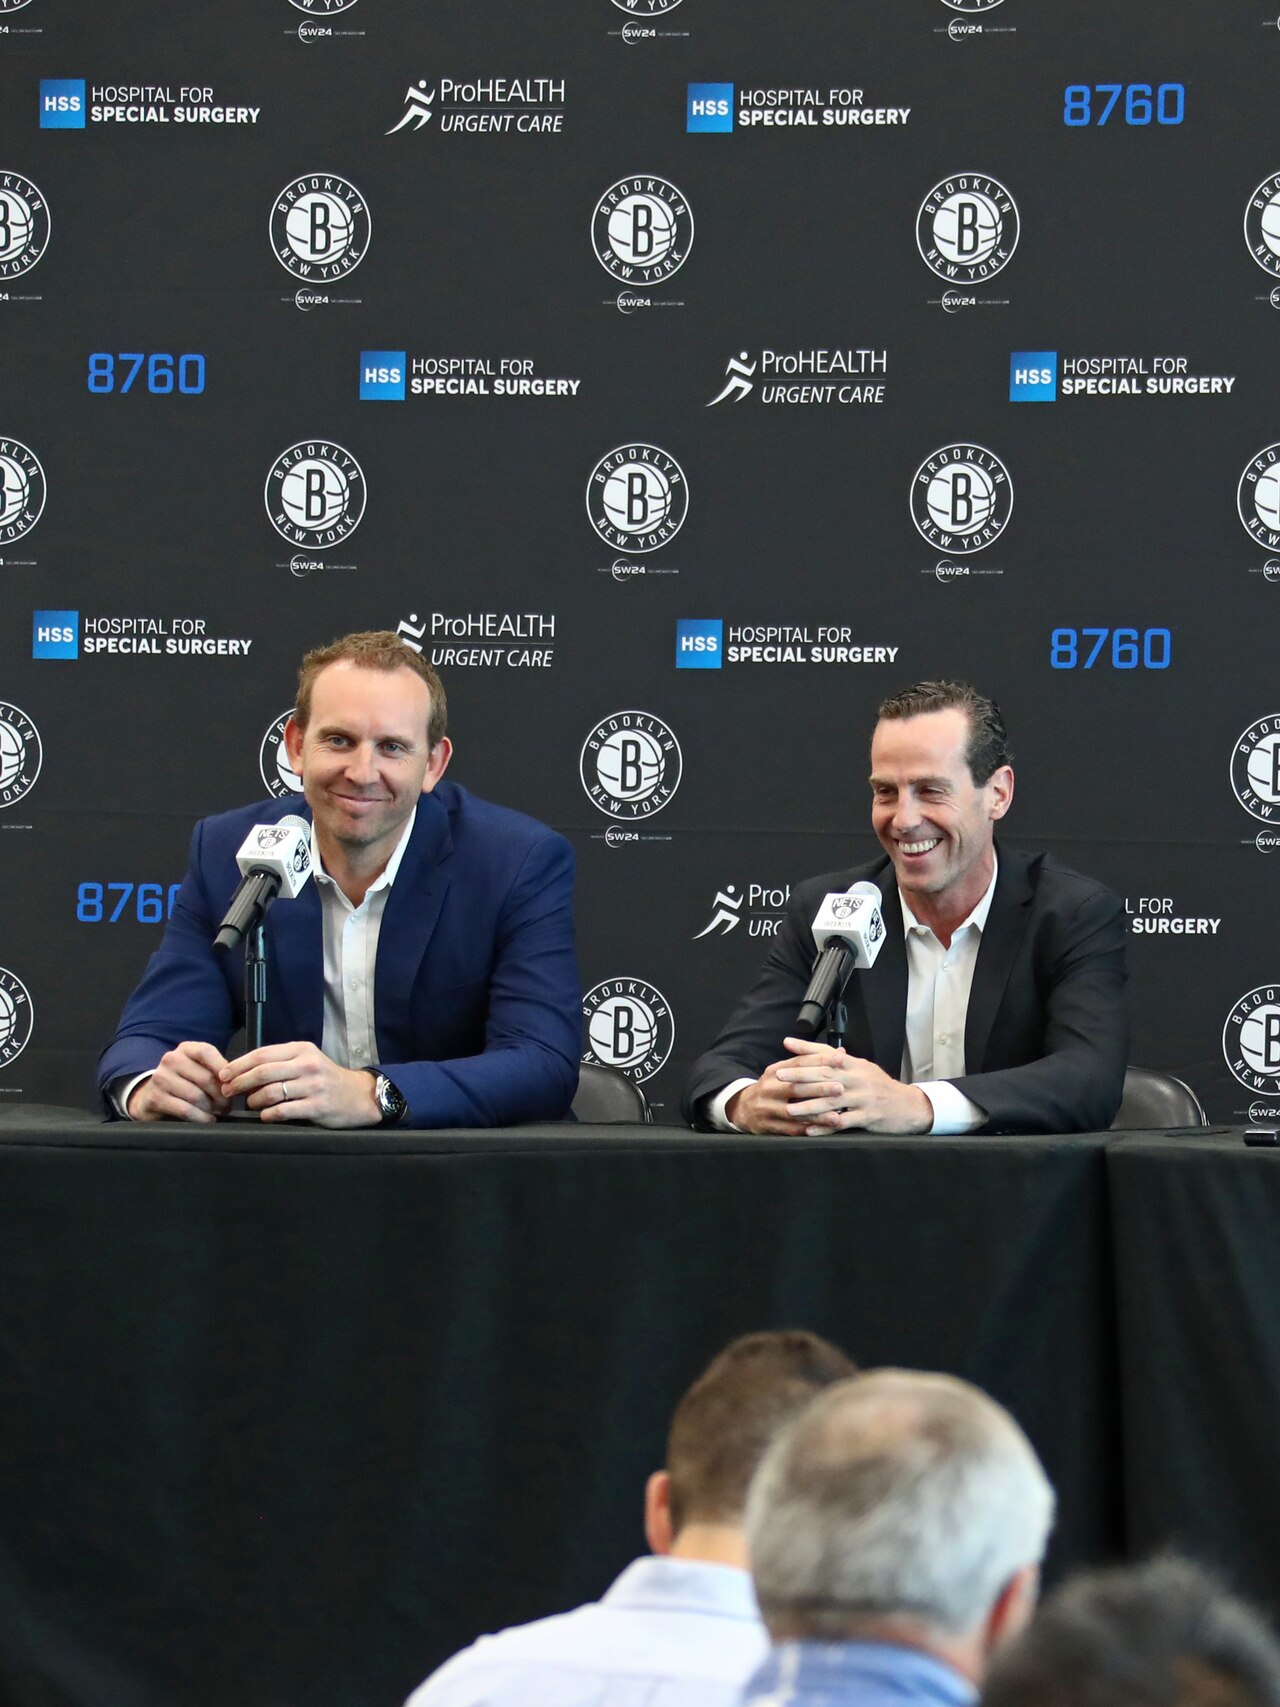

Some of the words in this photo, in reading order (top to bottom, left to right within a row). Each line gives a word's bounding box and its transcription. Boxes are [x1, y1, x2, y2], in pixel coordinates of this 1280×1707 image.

[92, 86, 175, 103] HOSPITAL
[180, 87, 213, 103] FOR
[441, 79, 565, 102] ProHEALTH
[740, 90, 825, 106] HOSPITAL
[830, 89, 863, 105] FOR
[45, 96, 80, 111] HSS
[693, 100, 728, 115] HSS
[1064, 83, 1186, 126] 8760
[91, 106, 169, 122] SPECIAL
[173, 106, 260, 123] SURGERY
[738, 109, 818, 126] SPECIAL
[822, 108, 911, 125] SURGERY
[441, 115, 515, 132] URGENT
[517, 115, 564, 132] CARE
[278, 178, 363, 213] BROOKLYN
[925, 178, 1011, 214] BROOKLYN
[957, 202, 979, 255] B
[280, 247, 311, 275] NEW
[321, 248, 359, 278] YORK
[927, 249, 958, 277] NEW
[968, 249, 1007, 279] YORK
[943, 297, 976, 305] SW24
[412, 358, 496, 375] HOSPITAL
[500, 359, 534, 375] FOR
[762, 350, 887, 373] ProHEALTH
[1064, 358, 1148, 375] HOSPITAL
[1153, 358, 1187, 374] FOR
[88, 353, 206, 395] 8760
[365, 368, 401, 383] HSS
[1016, 369, 1052, 384] HSS
[411, 378, 489, 394] SPECIAL
[493, 379, 581, 395] SURGERY
[762, 386, 836, 403] URGENT
[838, 386, 885, 403] CARE
[1062, 378, 1142, 395] SPECIAL
[1146, 377, 1235, 394] SURGERY
[595, 449, 680, 483] BROOKLYN
[627, 473, 648, 525] B
[597, 518, 628, 546] NEW
[638, 519, 677, 548] YORK
[1248, 518, 1280, 545] NEW
[613, 566, 646, 574] SW24
[85, 618, 168, 634] HOSPITAL
[173, 619, 206, 635] FOR
[432, 613, 555, 637] ProHEALTH
[38, 627, 73, 642] HSS
[729, 627, 813, 643] HOSPITAL
[818, 627, 851, 643] FOR
[84, 637, 161, 654] SPECIAL
[166, 638, 252, 655] SURGERY
[682, 636, 717, 652] HSS
[1051, 628, 1172, 669] 8760
[431, 649, 505, 666] URGENT
[507, 650, 554, 667] CARE
[727, 646, 806, 662] SPECIAL
[810, 646, 899, 663] SURGERY
[589, 716, 674, 750] BROOKLYN
[591, 785, 621, 812] NEW
[631, 786, 670, 815] YORK
[1241, 789, 1272, 817] NEW
[258, 829, 287, 838] NETS
[833, 898, 863, 909] NETS
[1139, 898, 1173, 914] FOR
[1132, 918, 1221, 934] SURGERY
[1234, 1060, 1265, 1088] NEW
